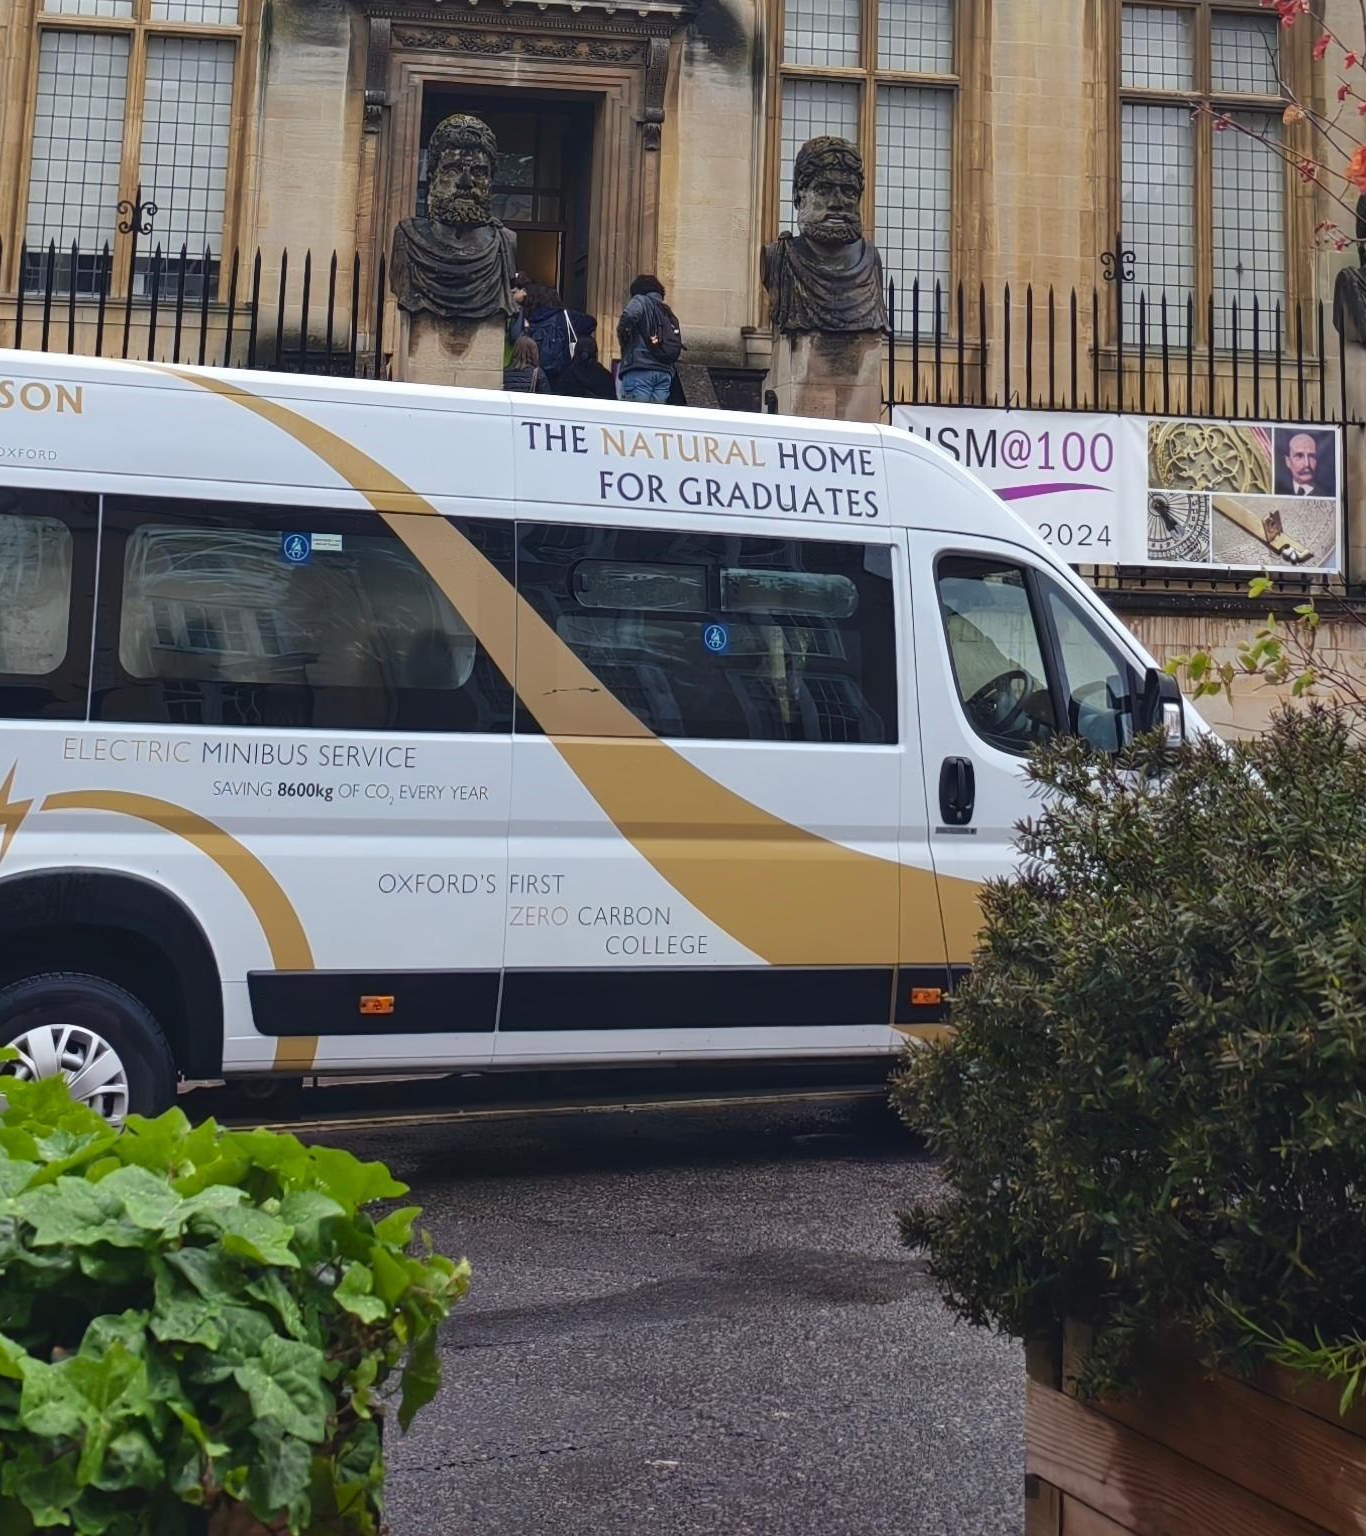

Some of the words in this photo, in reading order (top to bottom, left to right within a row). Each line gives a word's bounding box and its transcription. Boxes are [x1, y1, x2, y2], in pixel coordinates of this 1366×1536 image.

[521, 421, 588, 454] THE
[599, 427, 766, 468] NATURAL
[777, 442, 876, 476] HOME
[908, 426, 1114, 473] SM@100
[599, 471, 667, 504] FOR
[678, 476, 879, 519] GRADUATES
[1037, 522, 1112, 547] 2024
[62, 737, 192, 764] ELECTRIC
[201, 742, 309, 767] MINIBUS
[318, 744, 417, 769] SERVICE
[212, 780, 273, 798] SAVING
[277, 781, 334, 803] 8600kg
[338, 783, 360, 799] OF
[399, 784, 446, 800] EVERY
[450, 785, 489, 801] YEAR
[378, 873, 496, 895] OXFORD'S
[509, 874, 565, 895] FIRST
[508, 905, 569, 927] ZERO
[577, 905, 671, 927] CARBON
[605, 935, 708, 955] COLLEGE
